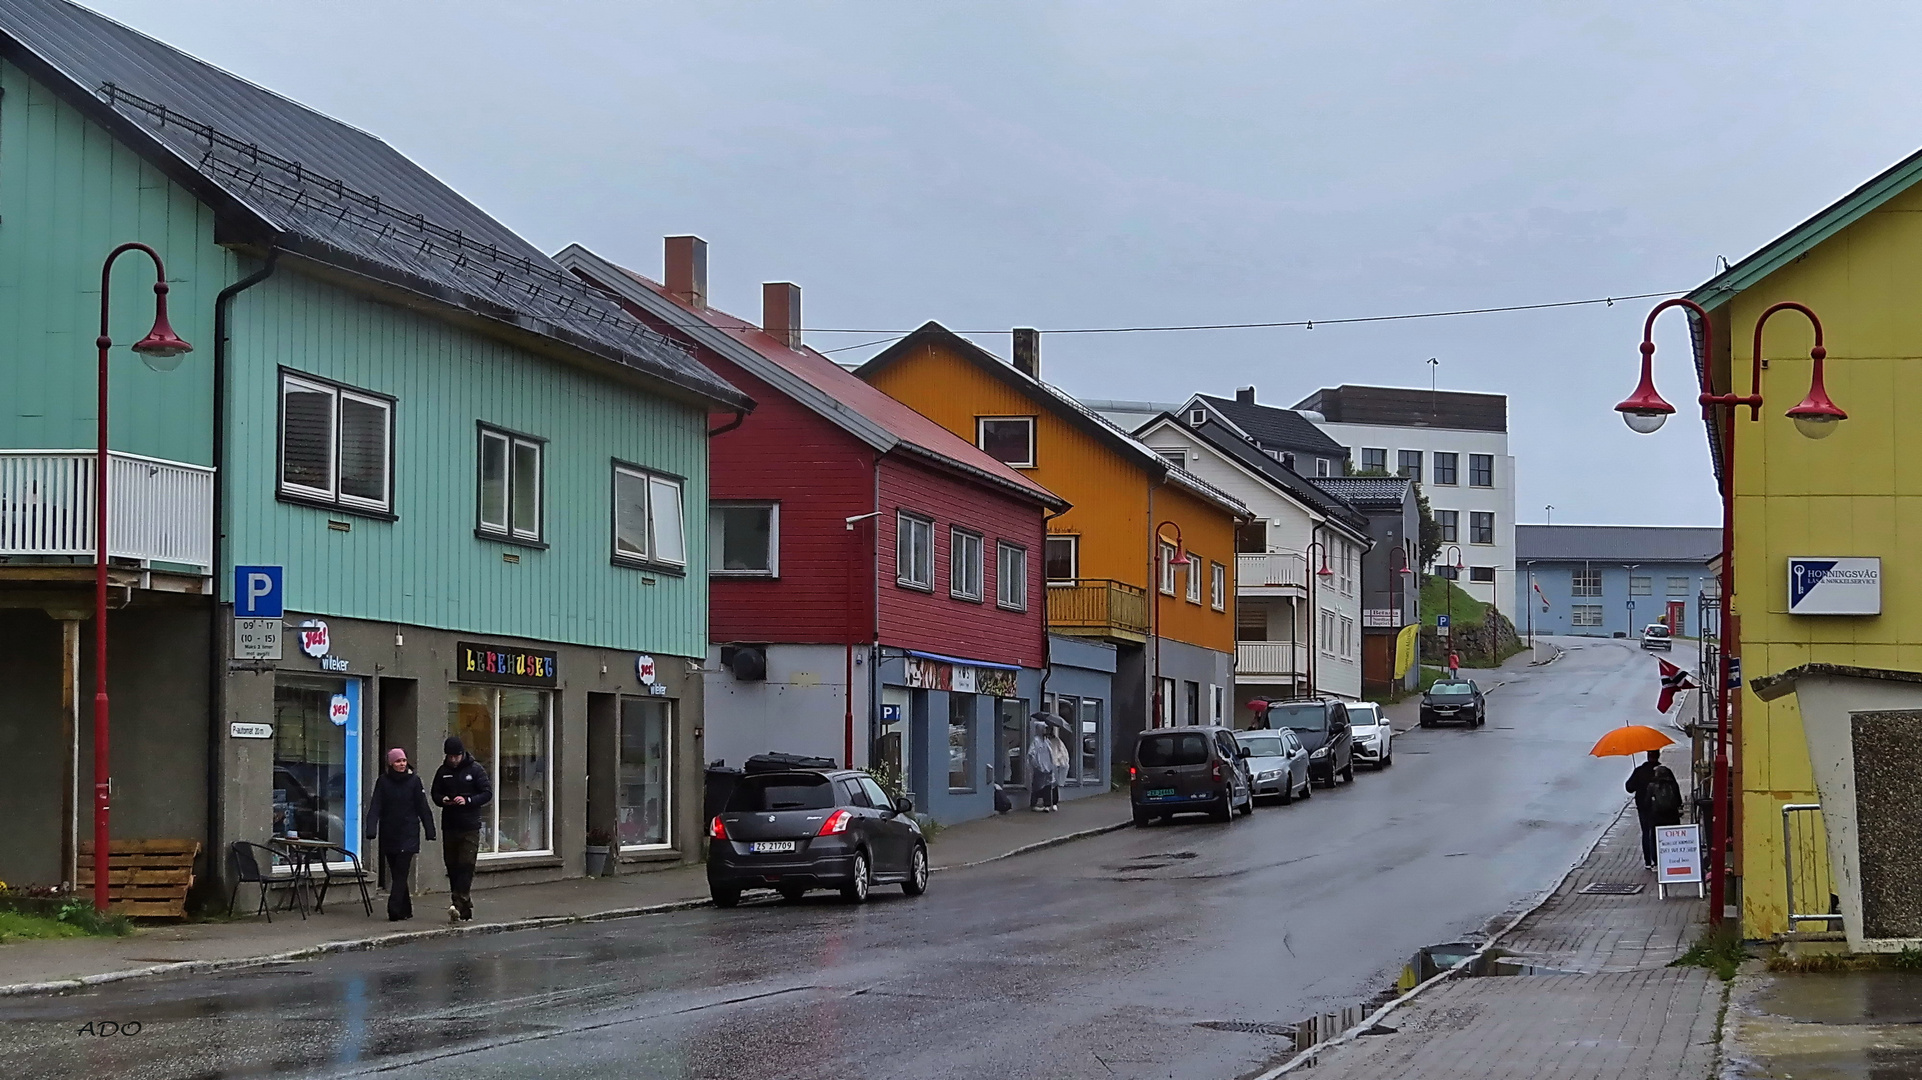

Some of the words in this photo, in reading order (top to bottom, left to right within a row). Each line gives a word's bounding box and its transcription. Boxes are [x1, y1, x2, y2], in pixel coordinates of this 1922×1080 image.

[1807, 569, 1878, 578] HONNINGSVÅG
[248, 573, 273, 612] P
[243, 621, 254, 630] 09
[266, 621, 274, 629] 17
[1440, 616, 1447, 626] P
[241, 634, 253, 643] (10
[264, 634, 276, 643] 15)
[305, 627, 327, 649] yes!
[466, 648, 553, 678] LEKEHUSET
[333, 702, 349, 717] yes!
[883, 706, 893, 719] P
[756, 841, 766, 850] ZS
[769, 840, 792, 850] 21709
